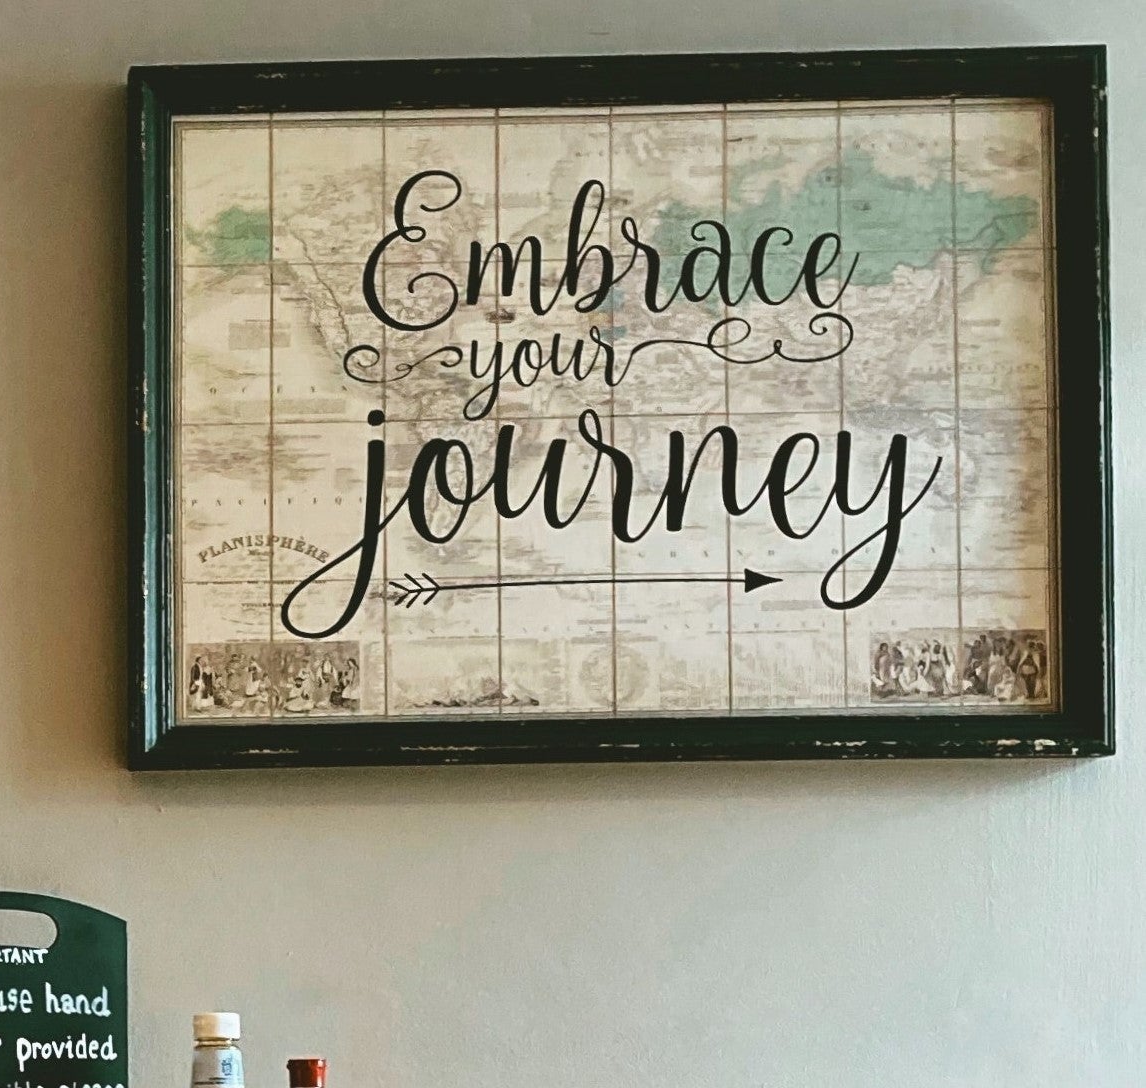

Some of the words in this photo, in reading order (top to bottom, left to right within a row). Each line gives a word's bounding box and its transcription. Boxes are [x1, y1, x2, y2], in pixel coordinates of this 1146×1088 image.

[361, 170, 860, 331] Embrace
[281, 408, 944, 639] journey
[197, 534, 330, 564] PLANISPHÈRE
[45, 982, 111, 1017] hand
[16, 1035, 118, 1072] provided
